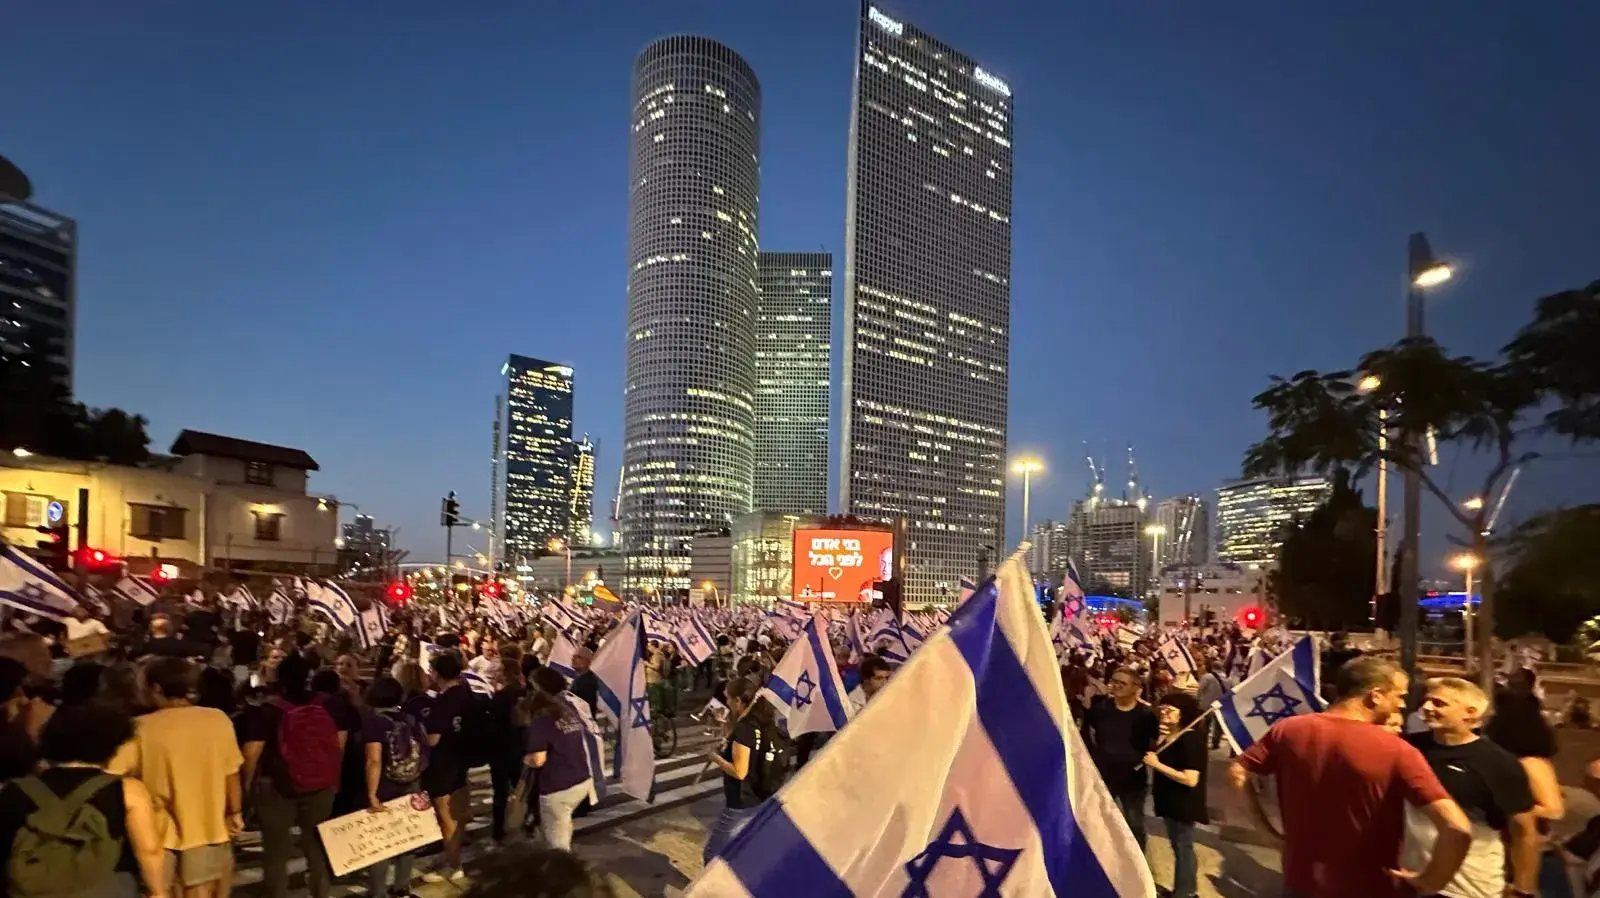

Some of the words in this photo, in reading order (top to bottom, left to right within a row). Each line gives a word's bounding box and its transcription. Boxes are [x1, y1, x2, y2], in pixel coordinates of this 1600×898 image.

[811, 538, 840, 550] אדם
[842, 538, 860, 551] בני
[808, 551, 834, 566] הכל
[836, 551, 863, 566] לפני
